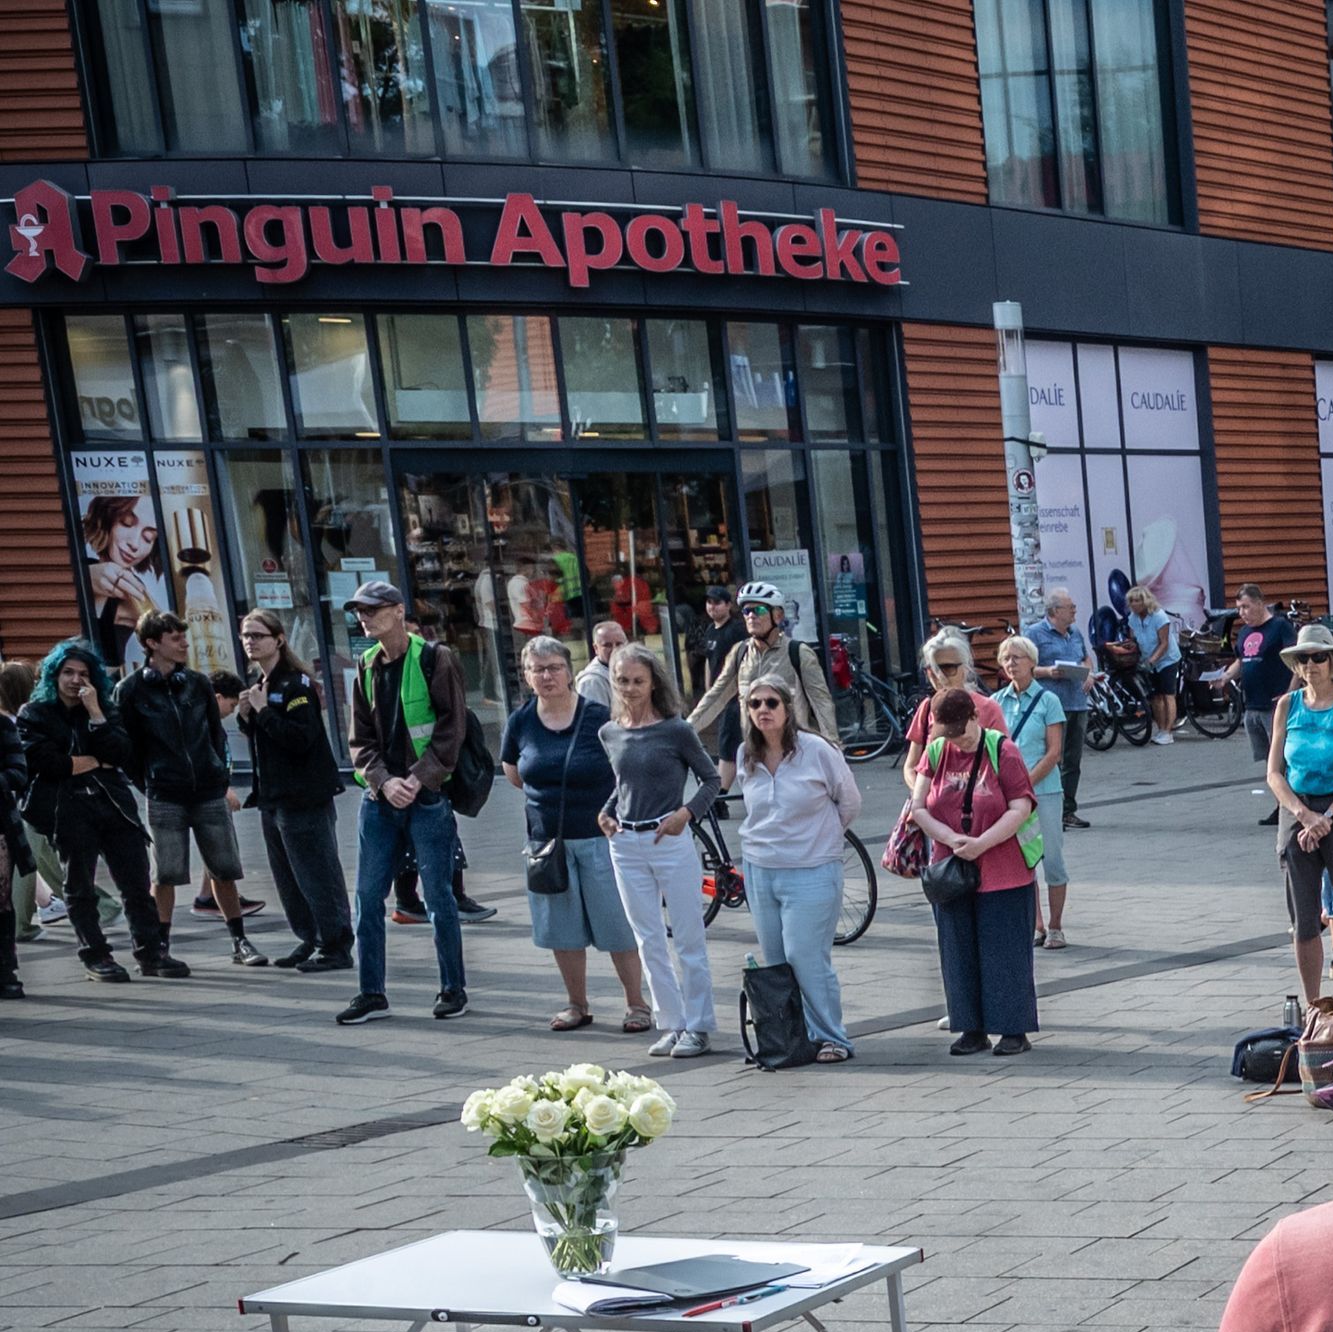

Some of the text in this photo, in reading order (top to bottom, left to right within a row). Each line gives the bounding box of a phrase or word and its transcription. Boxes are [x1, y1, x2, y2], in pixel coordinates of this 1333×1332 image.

[90, 185, 900, 288] Pinguin Apotheke
[74, 456, 129, 468] NUXE
[157, 459, 194, 467] NUXE
[81, 481, 146, 489] INNOVATION
[1039, 504, 1081, 518] issenschaft
[1040, 522, 1069, 533] einrebe
